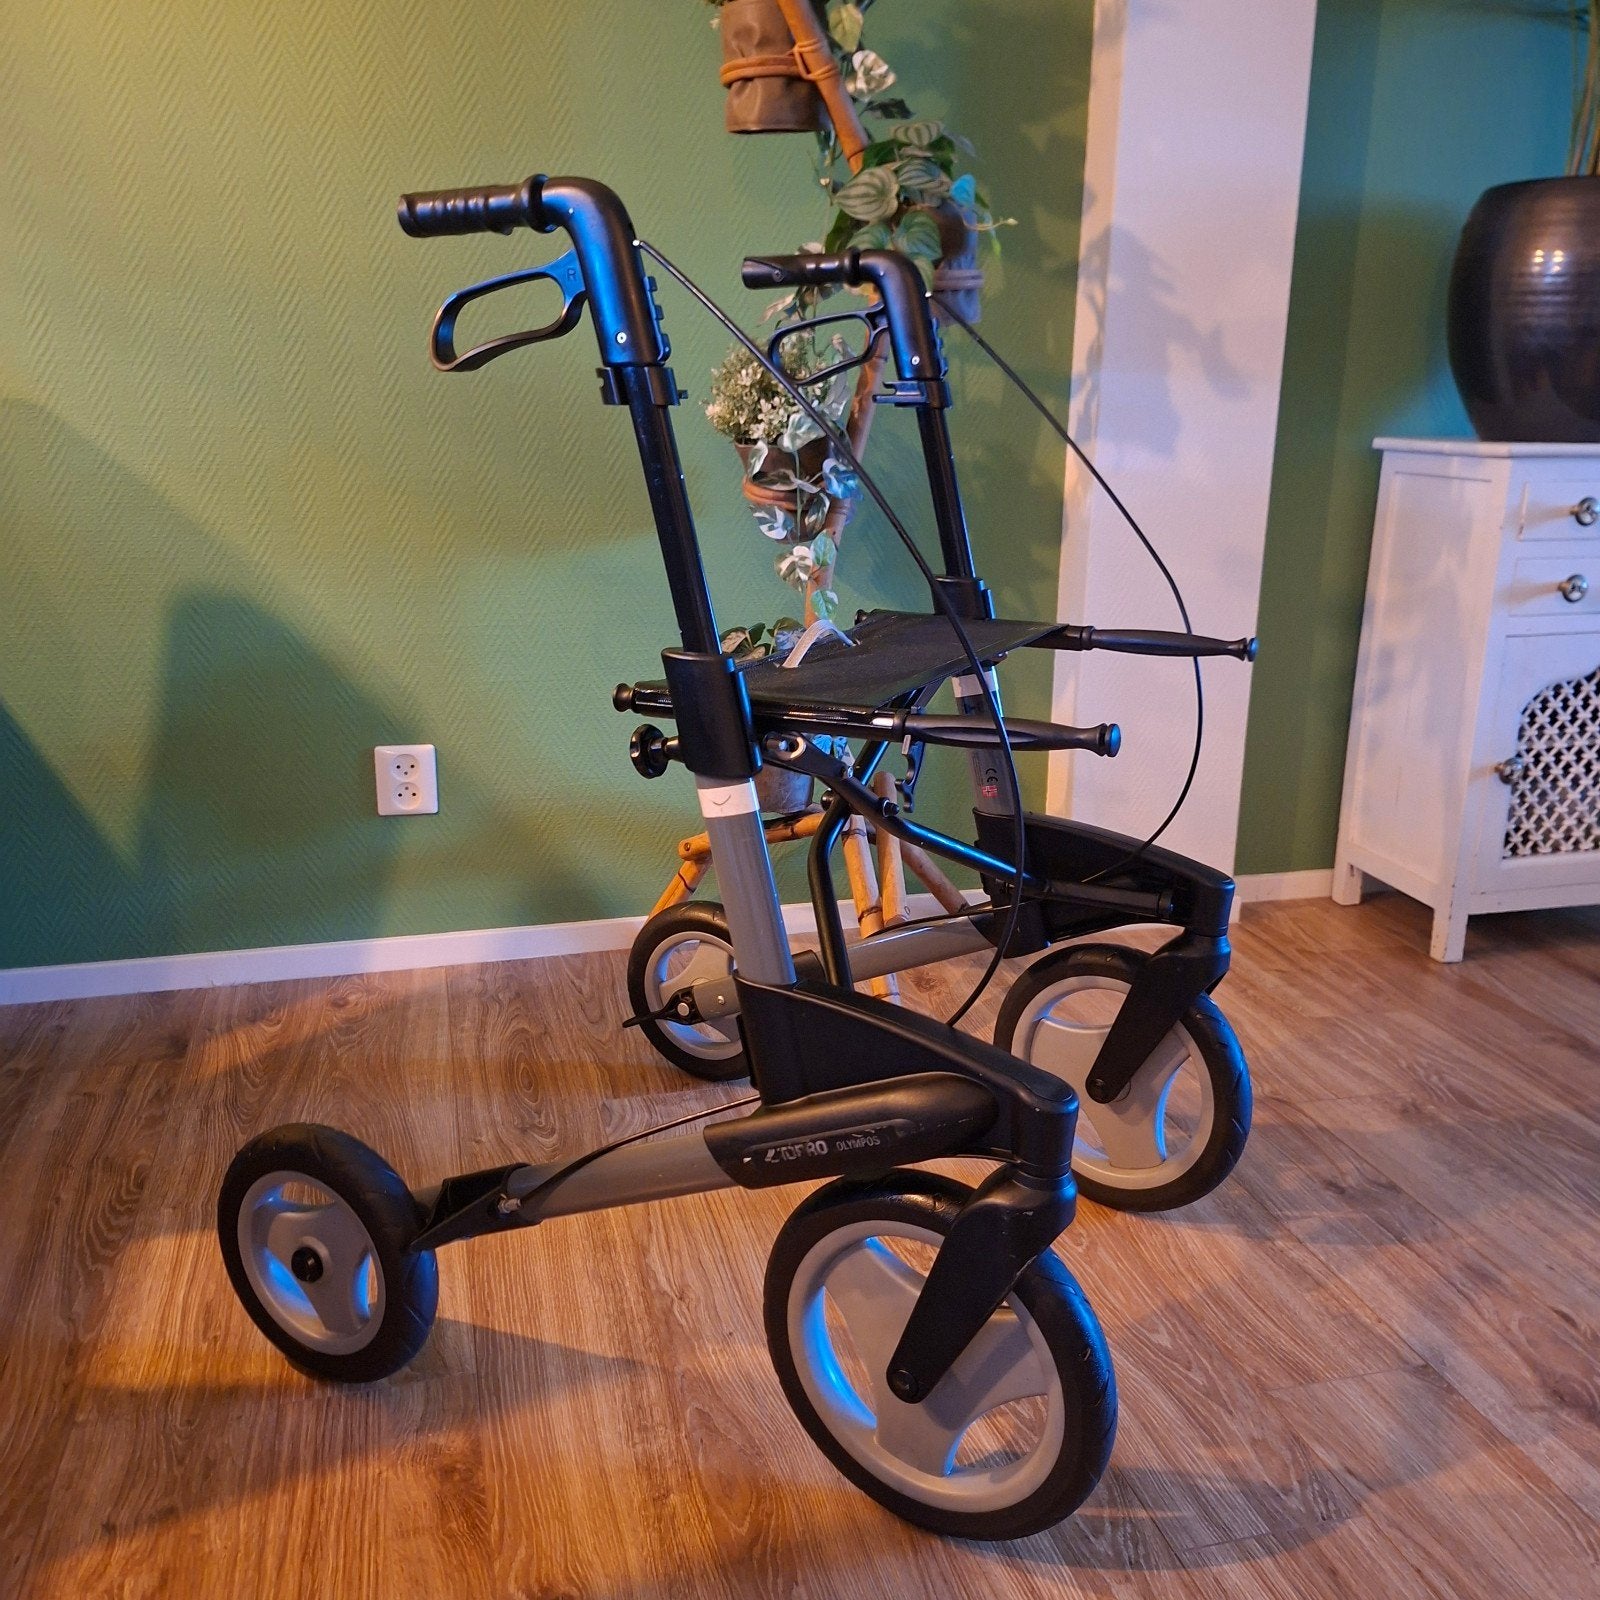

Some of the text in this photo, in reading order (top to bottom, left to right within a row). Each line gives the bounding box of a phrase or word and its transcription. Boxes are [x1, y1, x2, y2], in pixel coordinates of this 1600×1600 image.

[567, 267, 577, 282] R
[985, 768, 998, 782] CE
[836, 1135, 881, 1151] OLYMPOS
